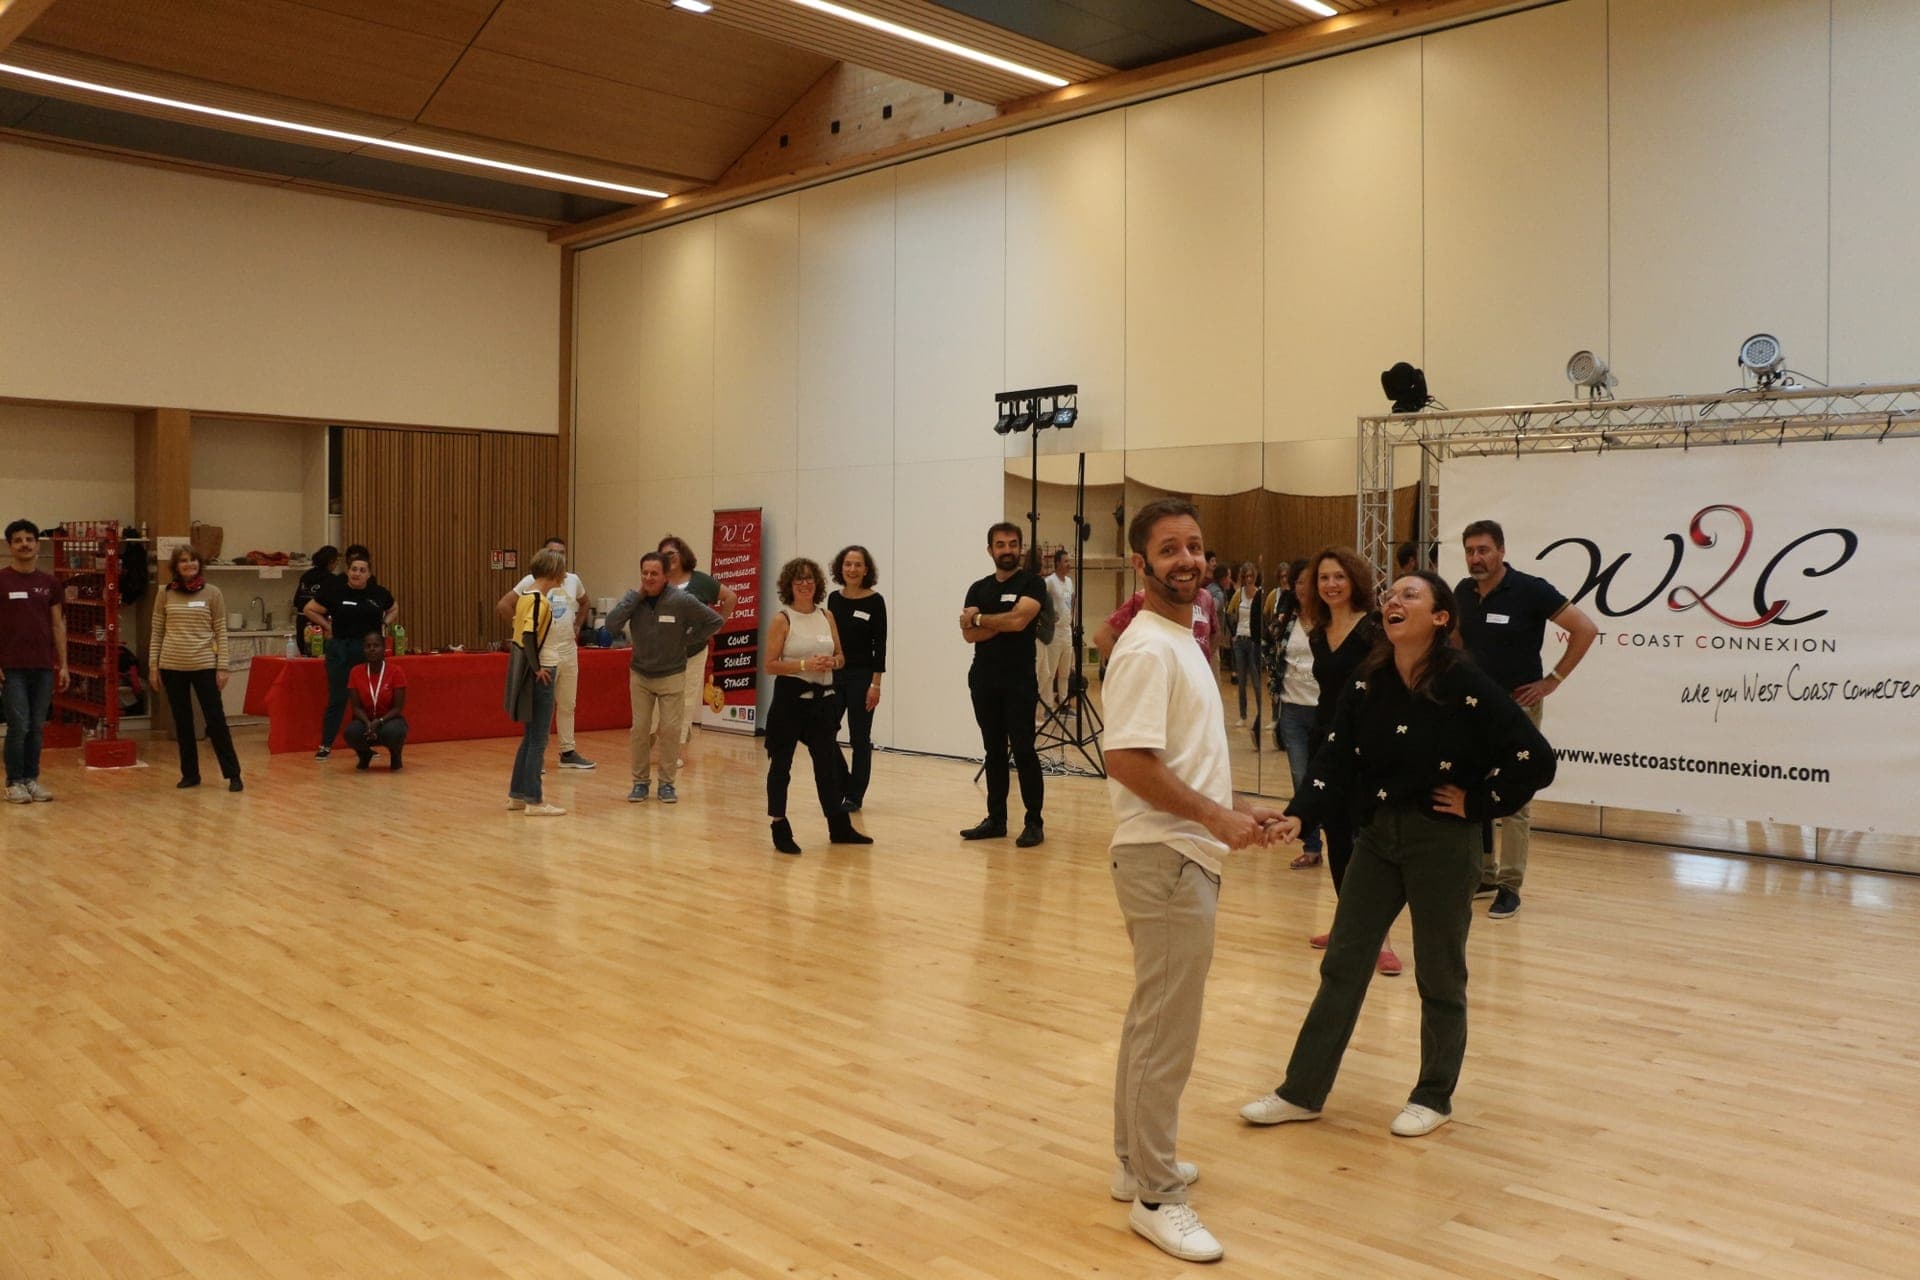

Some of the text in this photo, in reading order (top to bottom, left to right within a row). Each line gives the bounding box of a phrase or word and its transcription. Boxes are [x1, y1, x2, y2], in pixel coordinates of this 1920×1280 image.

[735, 609, 755, 618] SMILE
[1556, 631, 1836, 652] WT COAST CONNEXION
[724, 653, 751, 668] SOIRÉES
[724, 677, 749, 688] STAGES
